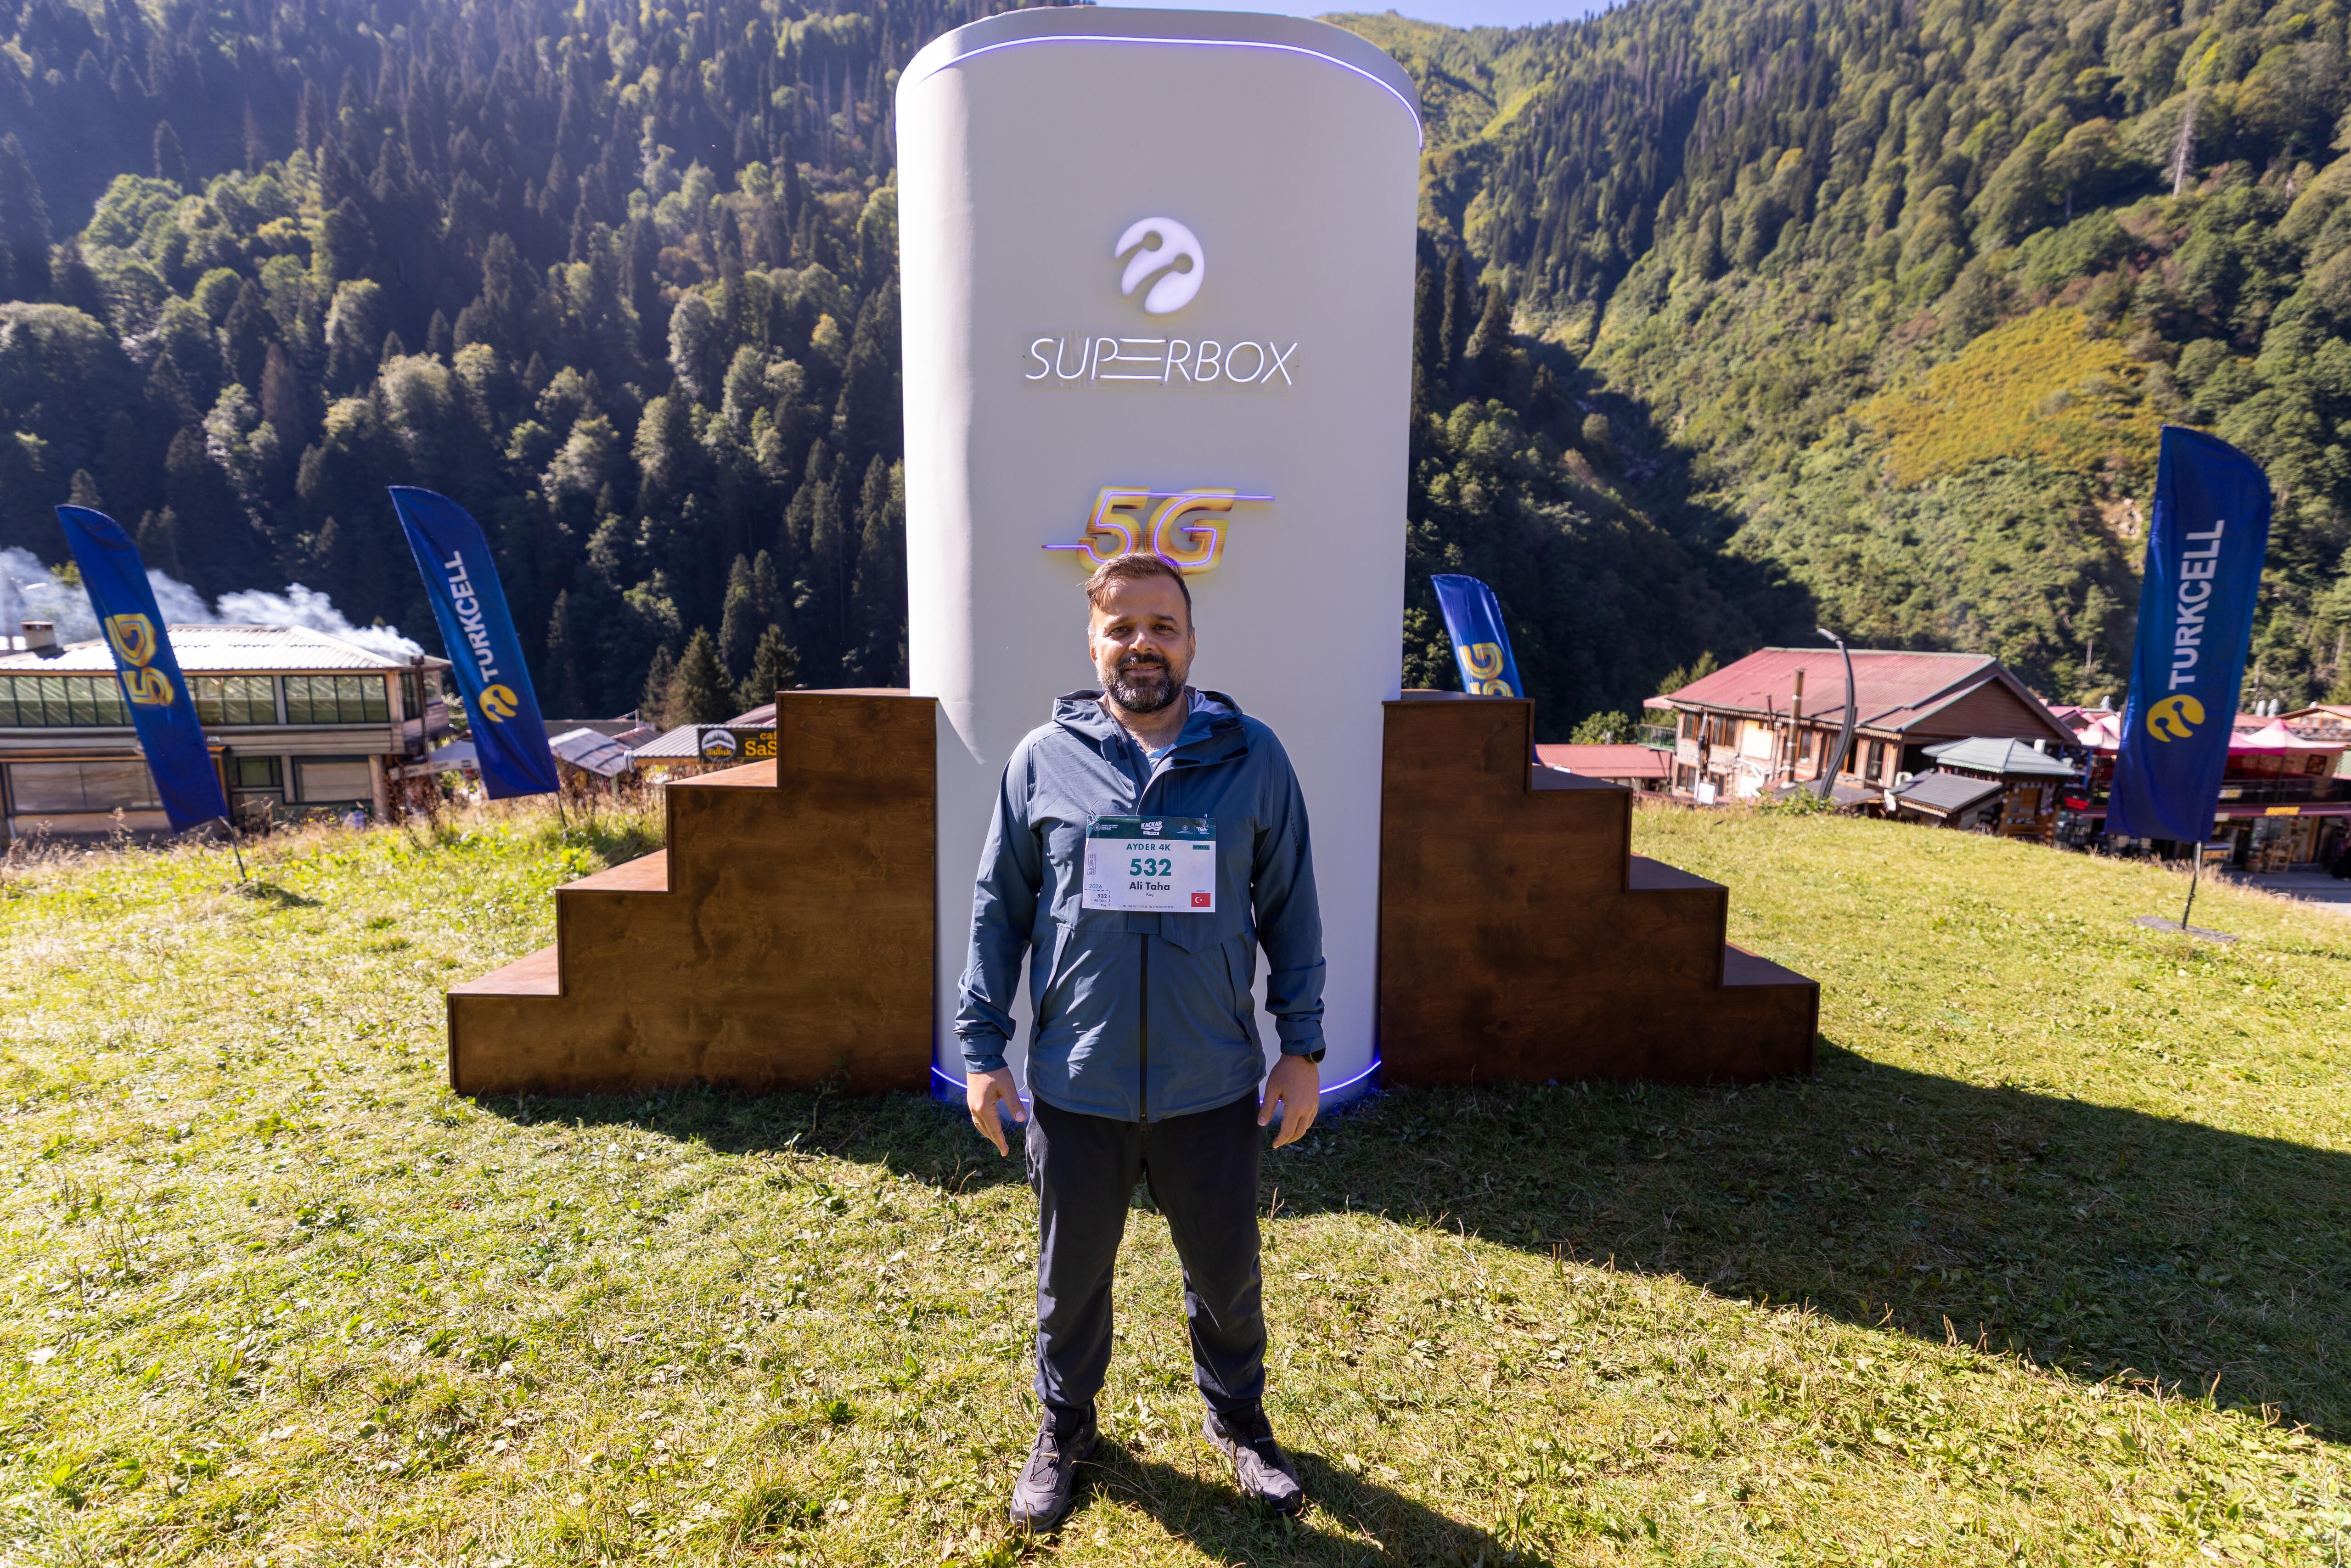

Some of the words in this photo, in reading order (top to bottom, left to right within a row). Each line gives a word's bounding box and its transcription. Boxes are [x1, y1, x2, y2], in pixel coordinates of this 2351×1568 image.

[1025, 337, 1298, 385] SUPERBOX
[1077, 486, 1237, 576] 5G
[444, 550, 499, 683] TURKCELL
[2168, 519, 2225, 690] TURKCELL
[104, 613, 174, 707] 5G
[1129, 881, 1143, 890] Ali
[1145, 882, 1170, 891] Taha
[1130, 858, 1172, 877] 532
